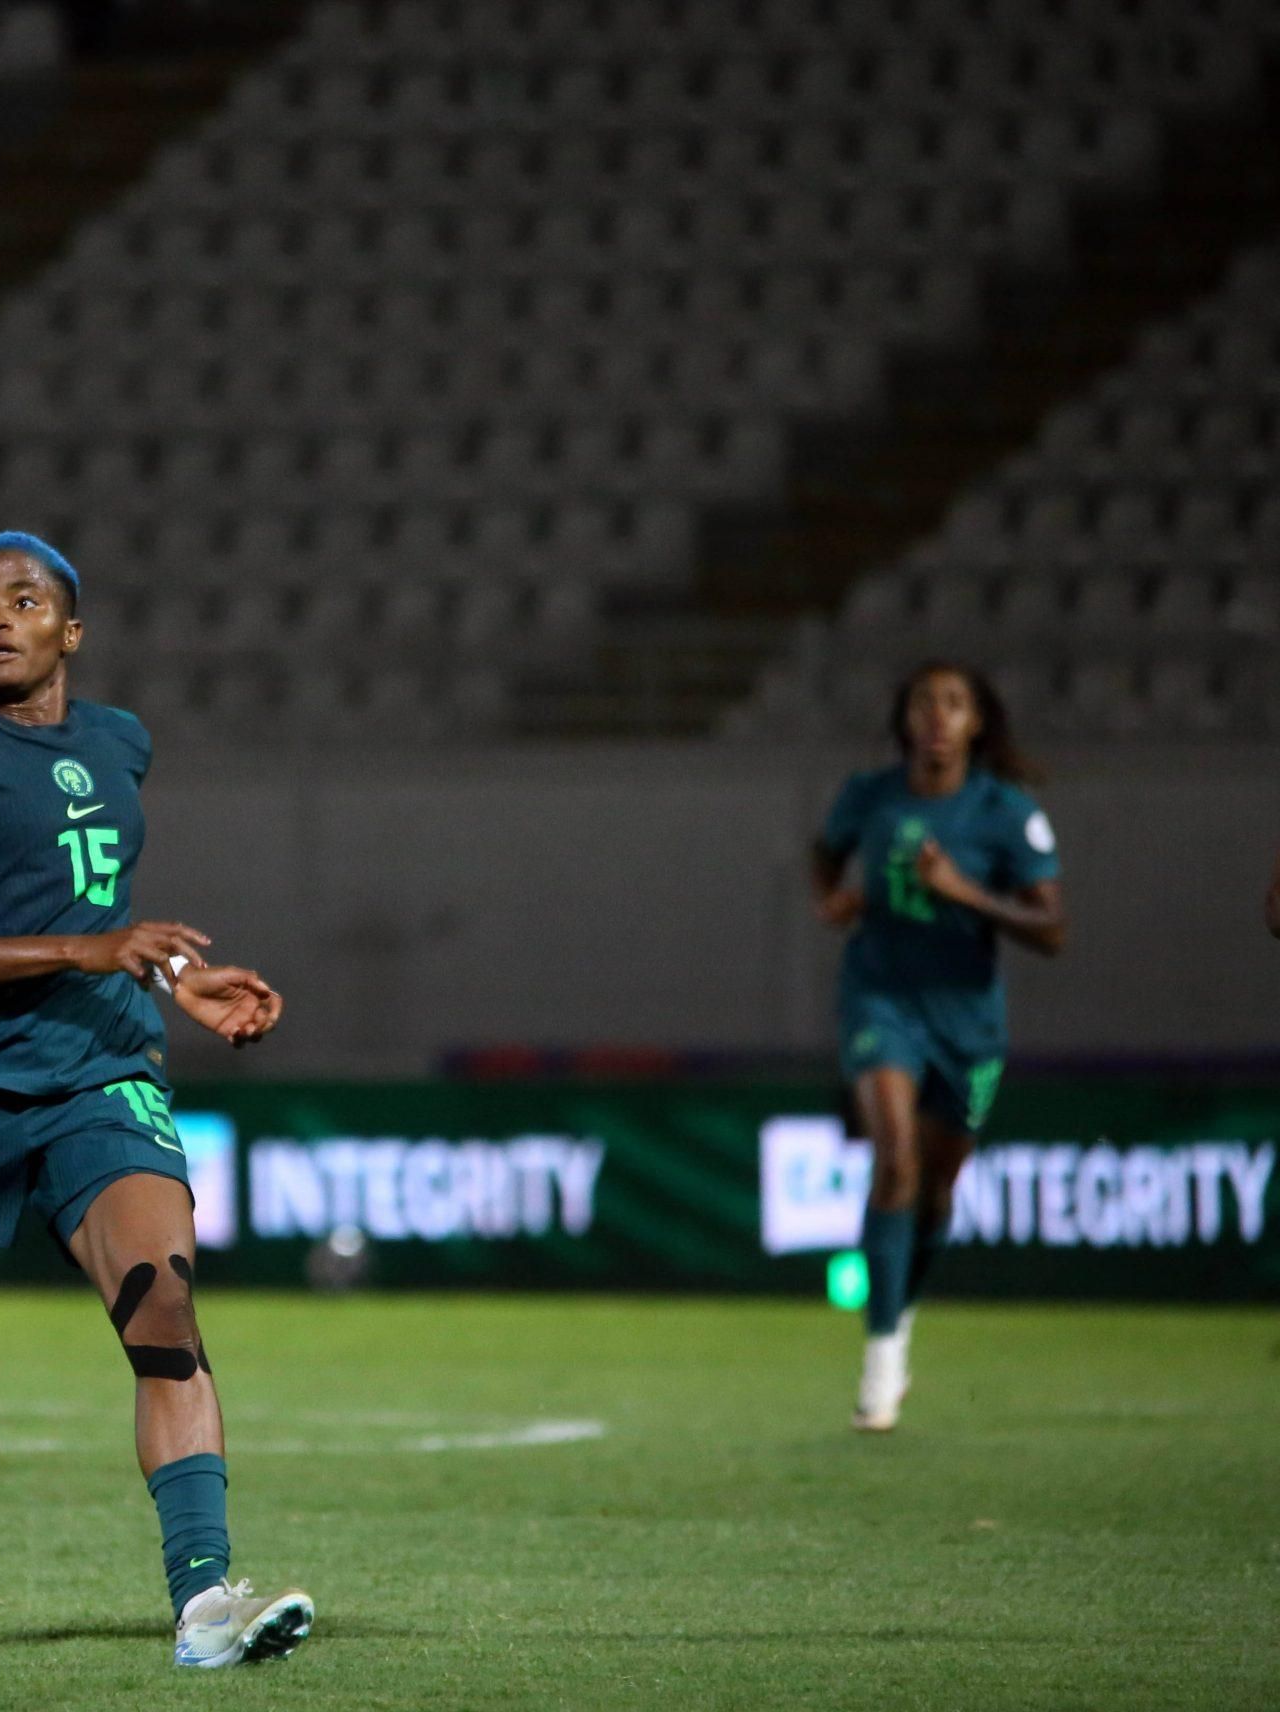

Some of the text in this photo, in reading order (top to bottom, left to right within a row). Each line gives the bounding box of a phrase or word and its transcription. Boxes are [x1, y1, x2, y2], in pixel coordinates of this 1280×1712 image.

[57, 828, 121, 907] 15
[102, 1080, 177, 1141] 15
[248, 1136, 602, 1238] INTEGRITY
[948, 1142, 1272, 1245] NTEGRITY
